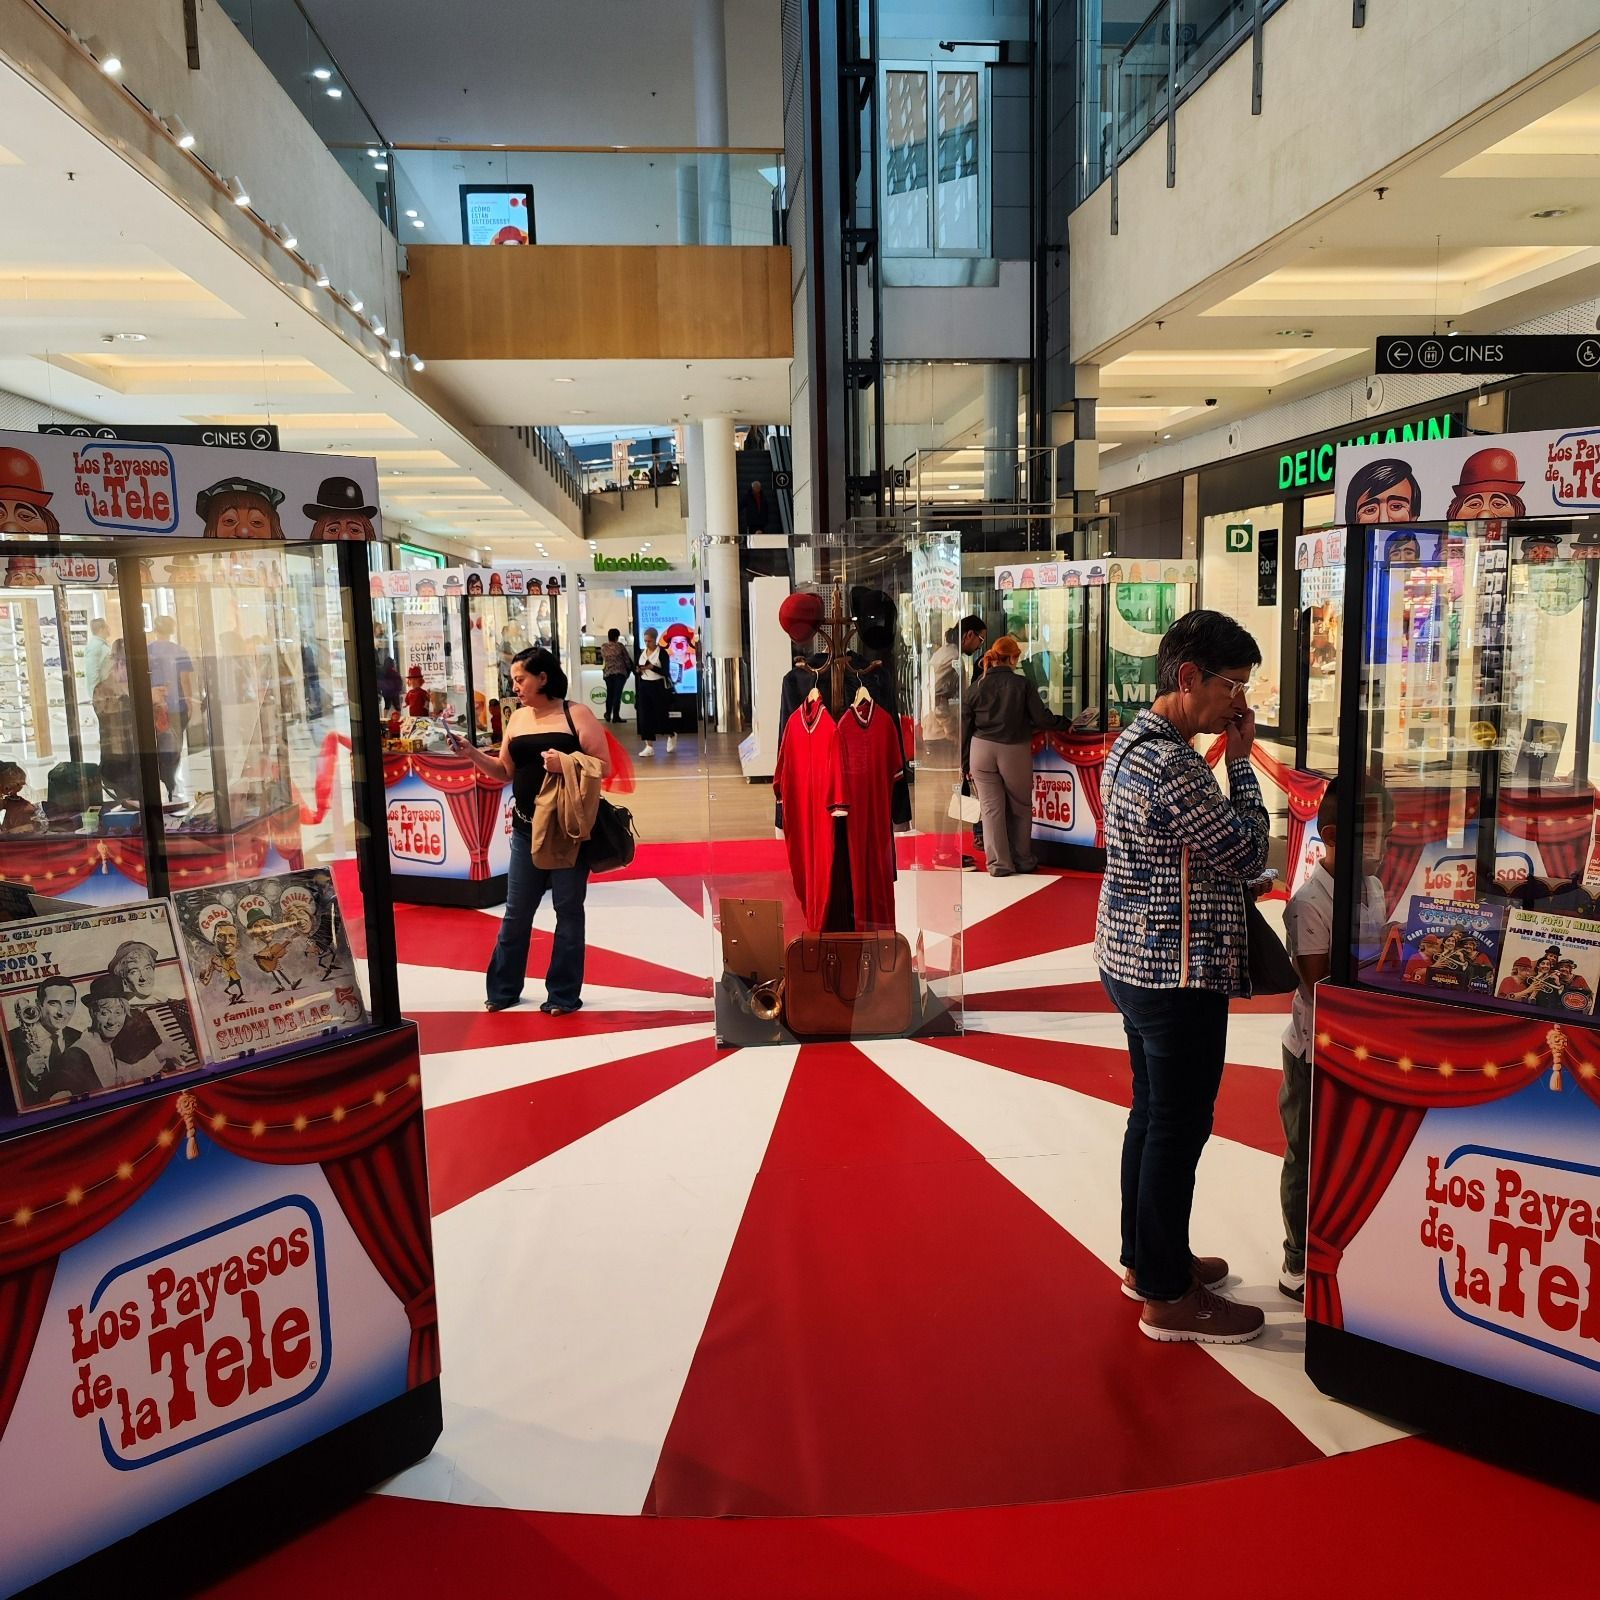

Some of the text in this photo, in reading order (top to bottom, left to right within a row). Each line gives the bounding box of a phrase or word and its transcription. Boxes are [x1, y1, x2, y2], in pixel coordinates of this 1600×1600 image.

[1449, 345, 1504, 362] CINES
[202, 431, 247, 447] CINES
[1548, 443, 1573, 463] Los
[73, 451, 169, 480] Los Payasos
[1545, 464, 1559, 481] de
[1559, 476, 1574, 498] la
[74, 476, 170, 521] de la Tele
[1230, 529, 1249, 548] D
[1036, 775, 1072, 795] Payasos
[401, 805, 441, 826] Payasos
[1036, 791, 1071, 823] Tele
[394, 834, 403, 851] la
[401, 823, 441, 856] Tele
[1424, 867, 1452, 889] Los
[240, 897, 265, 912] Fofo
[12, 928, 53, 939] CLUB
[54, 914, 126, 934] INFANTIL
[128, 911, 147, 921] DE
[201, 909, 228, 930] Gaby
[1541, 915, 1563, 928] FOFO
[1508, 927, 1533, 935] MAMI
[44, 951, 53, 964] Y
[0, 963, 61, 985] MILIKI
[213, 997, 295, 1027] y familia en el
[216, 1018, 270, 1050] SHOW
[273, 1012, 298, 1035] DE
[299, 1004, 333, 1029] LAS
[335, 986, 363, 1024] 5
[1426, 1155, 1485, 1212] Los
[1420, 1206, 1454, 1253] de
[1454, 1244, 1491, 1307] la
[68, 1227, 310, 1364] Los Payasos
[71, 1289, 313, 1450] de la Tele
